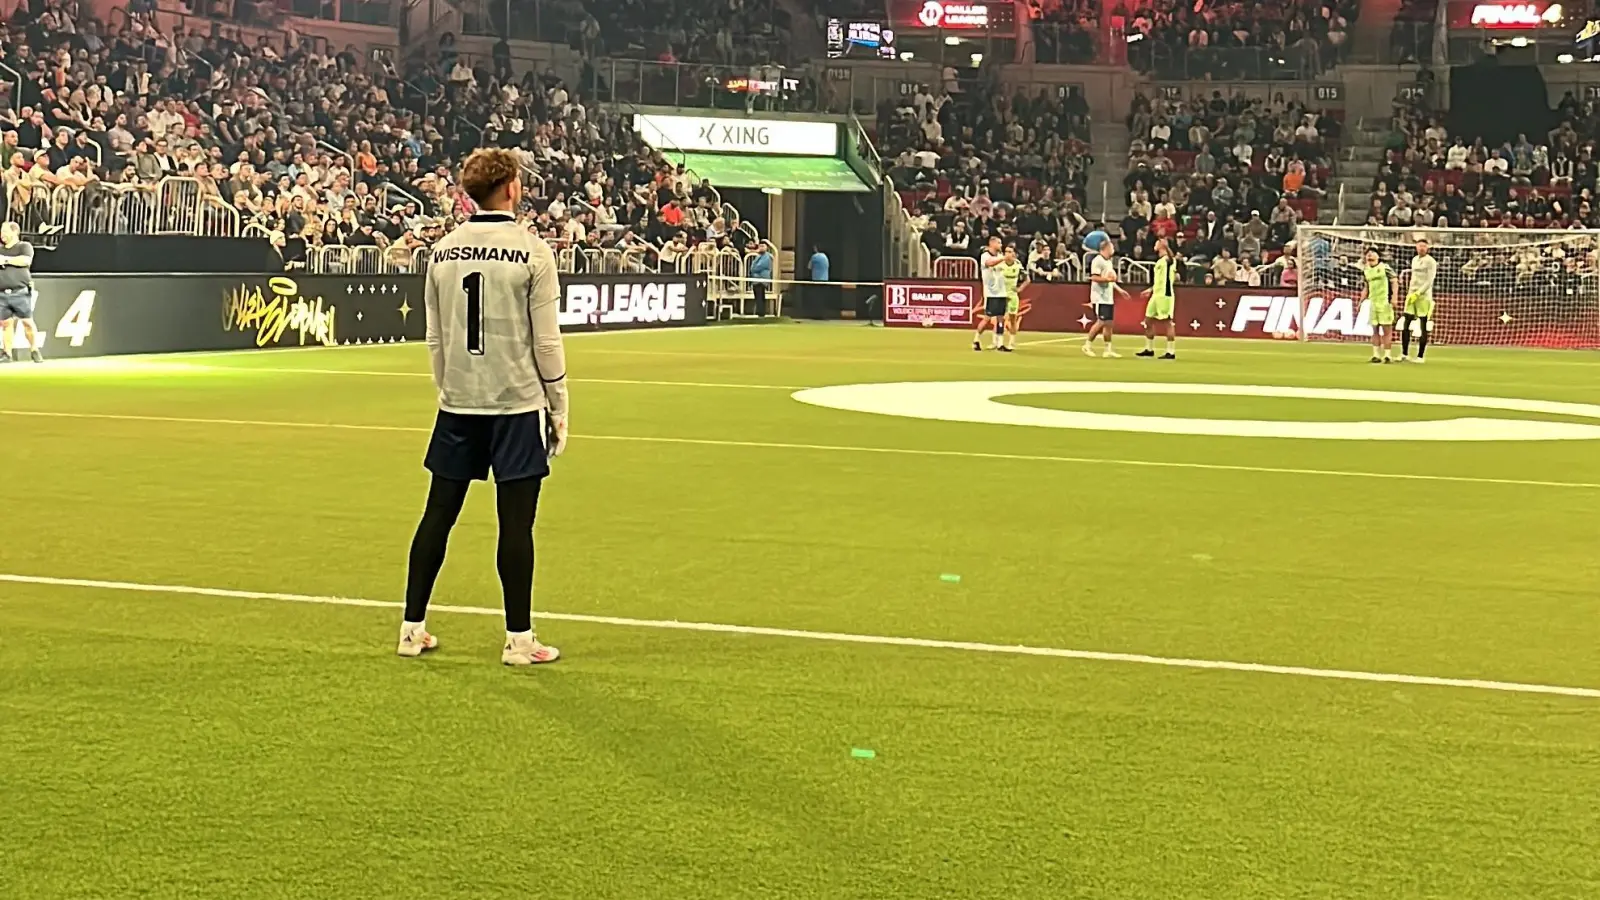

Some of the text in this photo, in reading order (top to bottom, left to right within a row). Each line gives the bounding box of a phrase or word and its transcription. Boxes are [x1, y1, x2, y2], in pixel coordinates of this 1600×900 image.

[1541, 4, 1562, 23] 4
[1318, 87, 1338, 99] 015
[722, 125, 770, 145] XING
[433, 246, 531, 264] WISSMANN
[600, 282, 687, 323] LEAGUE
[890, 286, 907, 306] B
[54, 289, 96, 347] 4
[462, 271, 485, 356] 1
